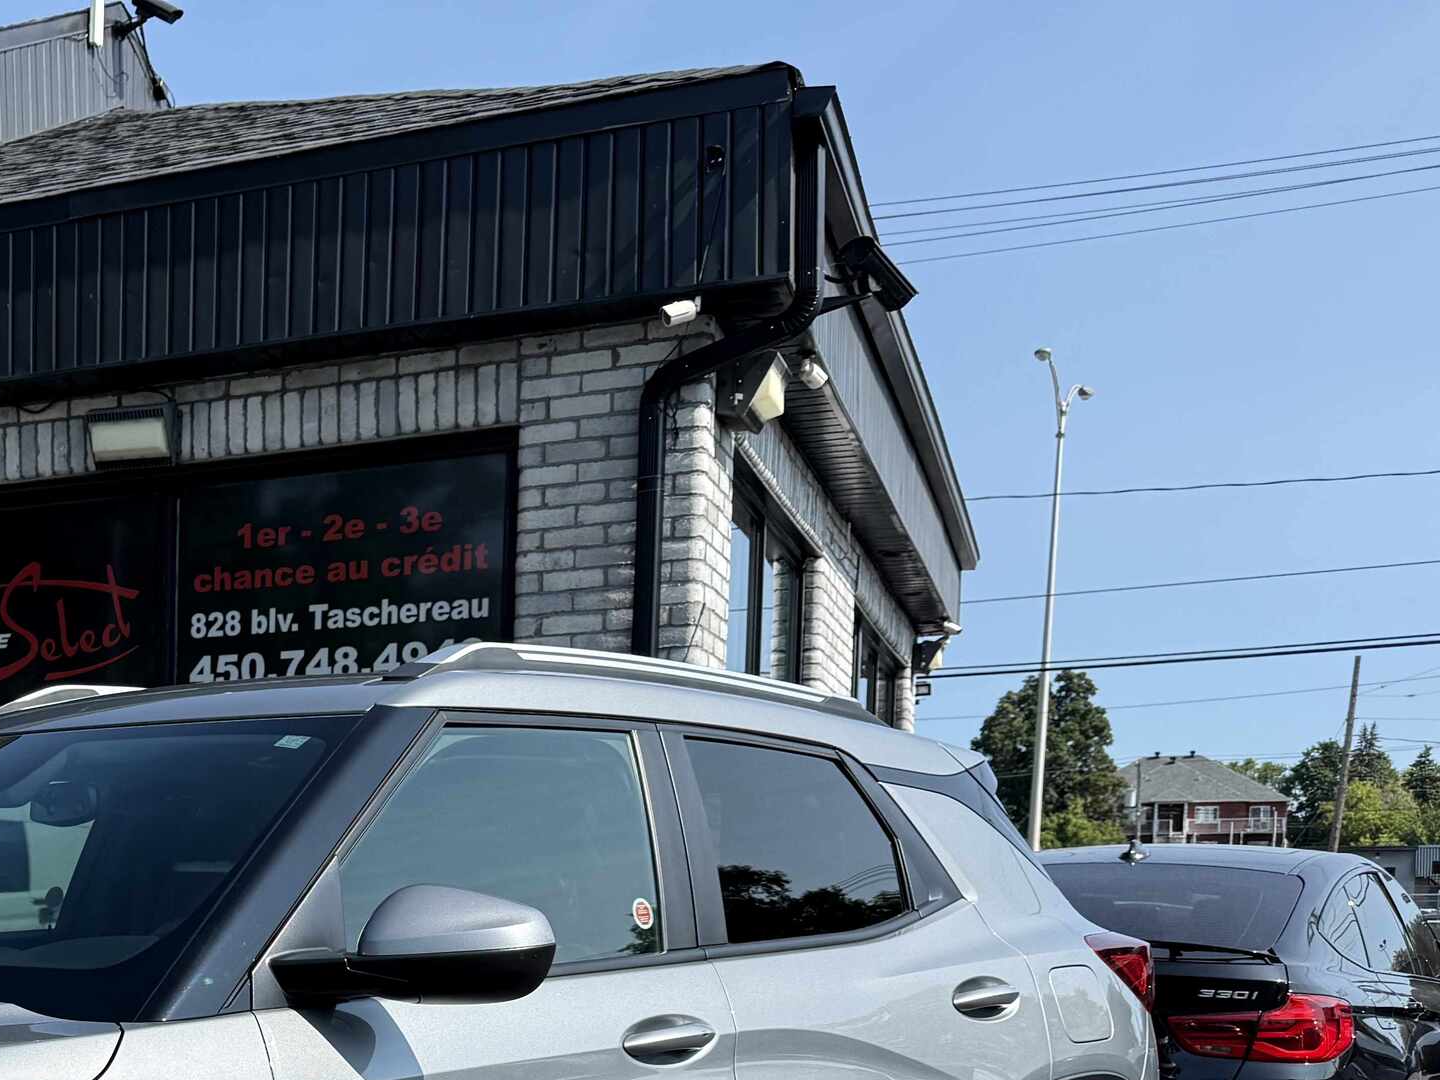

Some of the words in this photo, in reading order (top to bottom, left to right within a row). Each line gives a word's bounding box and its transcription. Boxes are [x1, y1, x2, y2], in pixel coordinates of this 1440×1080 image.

[238, 522, 292, 550] 1er
[322, 513, 367, 542] 2e
[399, 505, 444, 535] 3e
[193, 561, 315, 593] chance
[327, 558, 369, 583] au
[380, 542, 489, 577] crédit
[190, 610, 241, 639] 828
[251, 608, 299, 635] blv.
[309, 597, 490, 630] Taschereau
